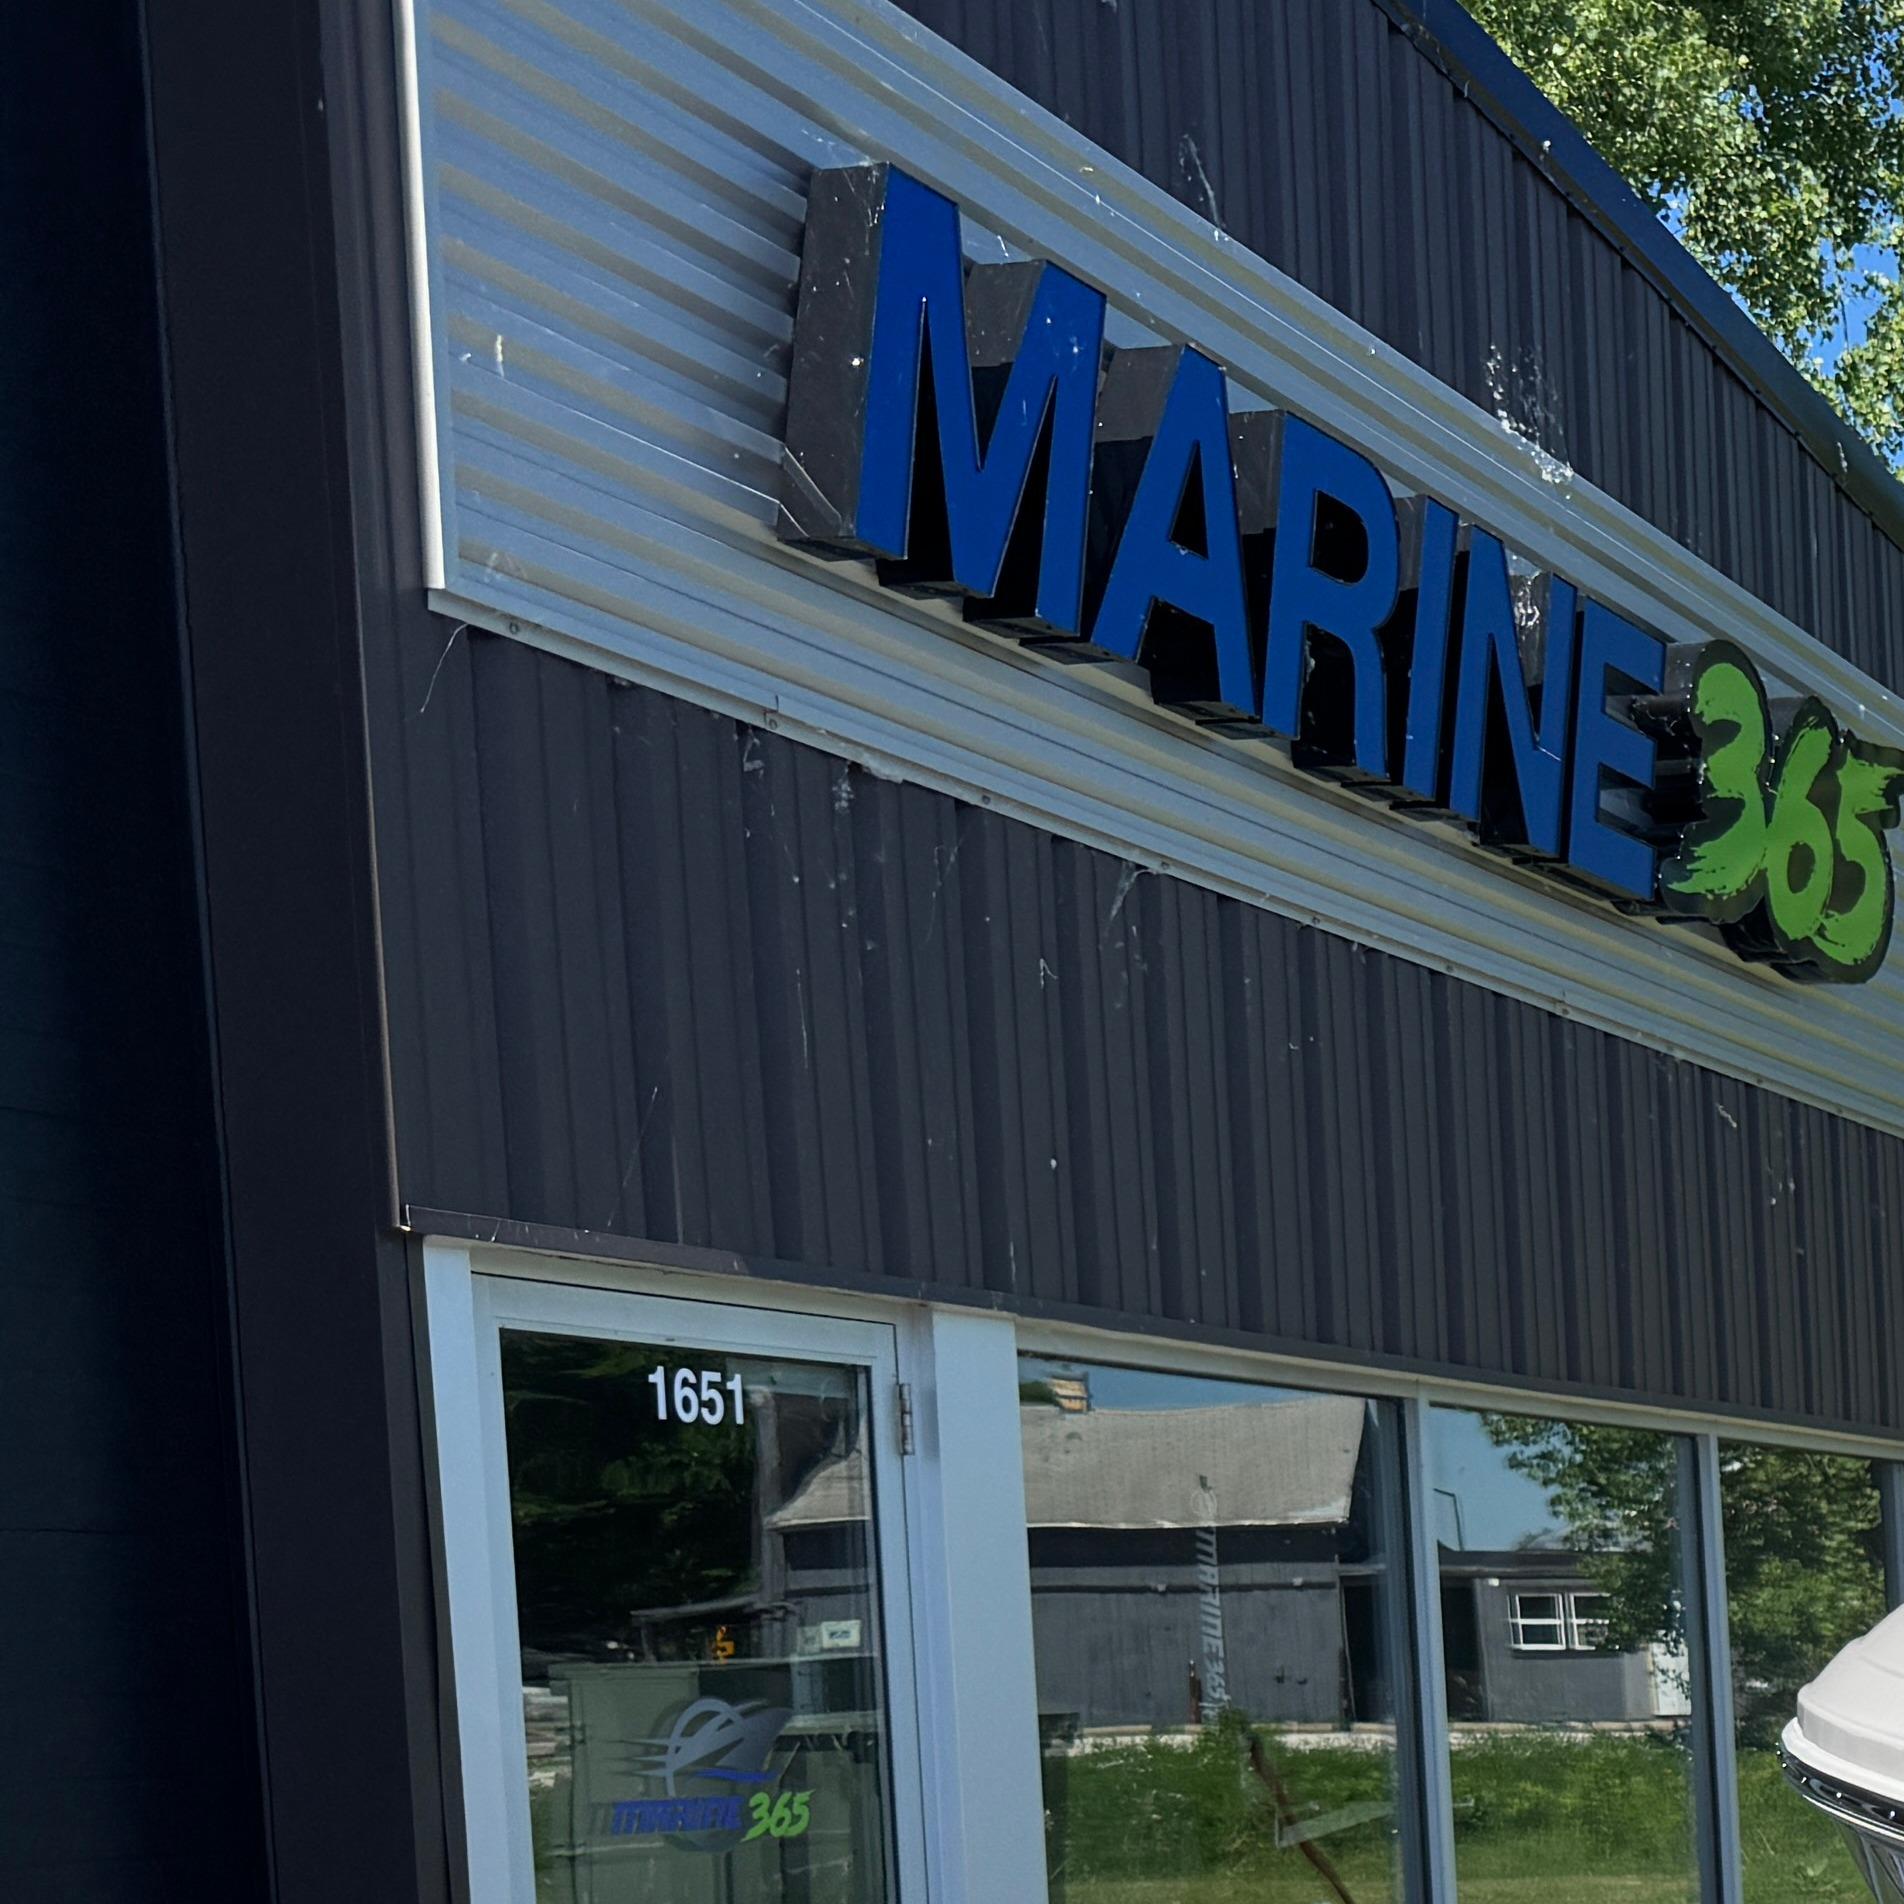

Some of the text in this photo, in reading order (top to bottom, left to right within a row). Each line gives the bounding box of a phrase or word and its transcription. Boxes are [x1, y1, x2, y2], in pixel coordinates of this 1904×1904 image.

[855, 162, 1665, 902] MARINE
[648, 1365, 744, 1425] 1651
[741, 1789, 816, 1843] 365
